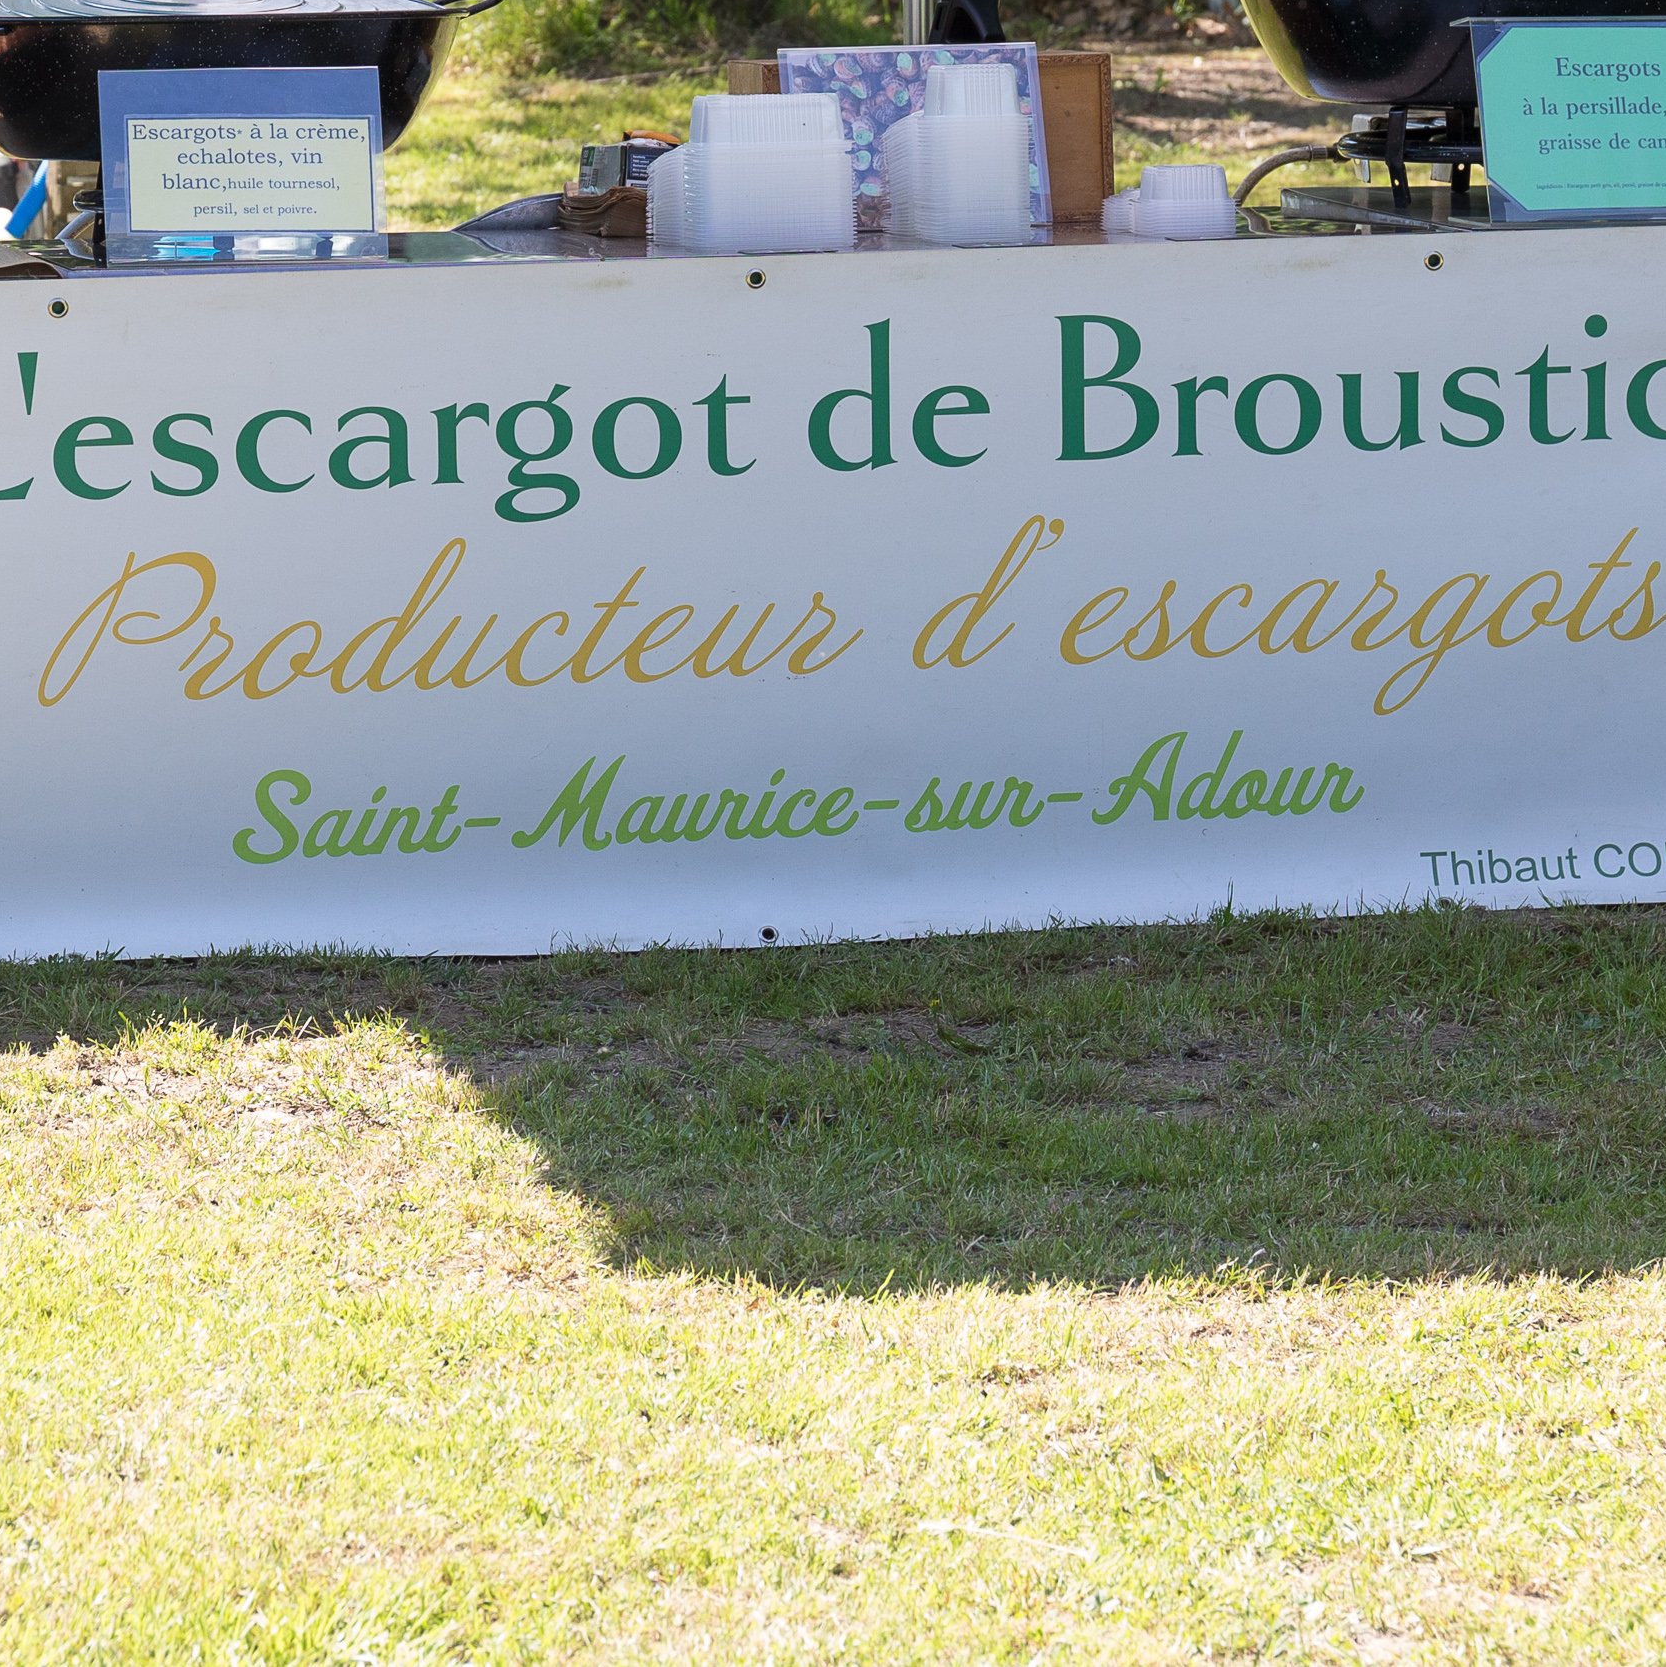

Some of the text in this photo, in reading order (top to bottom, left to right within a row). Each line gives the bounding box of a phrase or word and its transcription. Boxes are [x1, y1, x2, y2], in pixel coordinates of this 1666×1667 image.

[1555, 57, 1661, 82] Escargots
[1523, 98, 1533, 115] à
[1541, 97, 1558, 115] la
[250, 124, 263, 140] à
[270, 123, 289, 139] la
[295, 123, 366, 143] crème,
[1539, 133, 1602, 155] graisse
[1609, 133, 1630, 149] de
[177, 148, 323, 166] echalotes, vin
[268, 177, 340, 191] tournesol,
[194, 203, 317, 217] persil, sel et poivre.
[807, 317, 991, 474] de
[37, 536, 865, 709] Producteur
[232, 729, 1365, 865] Saint-Maurice-sur-Adour
[1420, 847, 1582, 888] Thibaut
